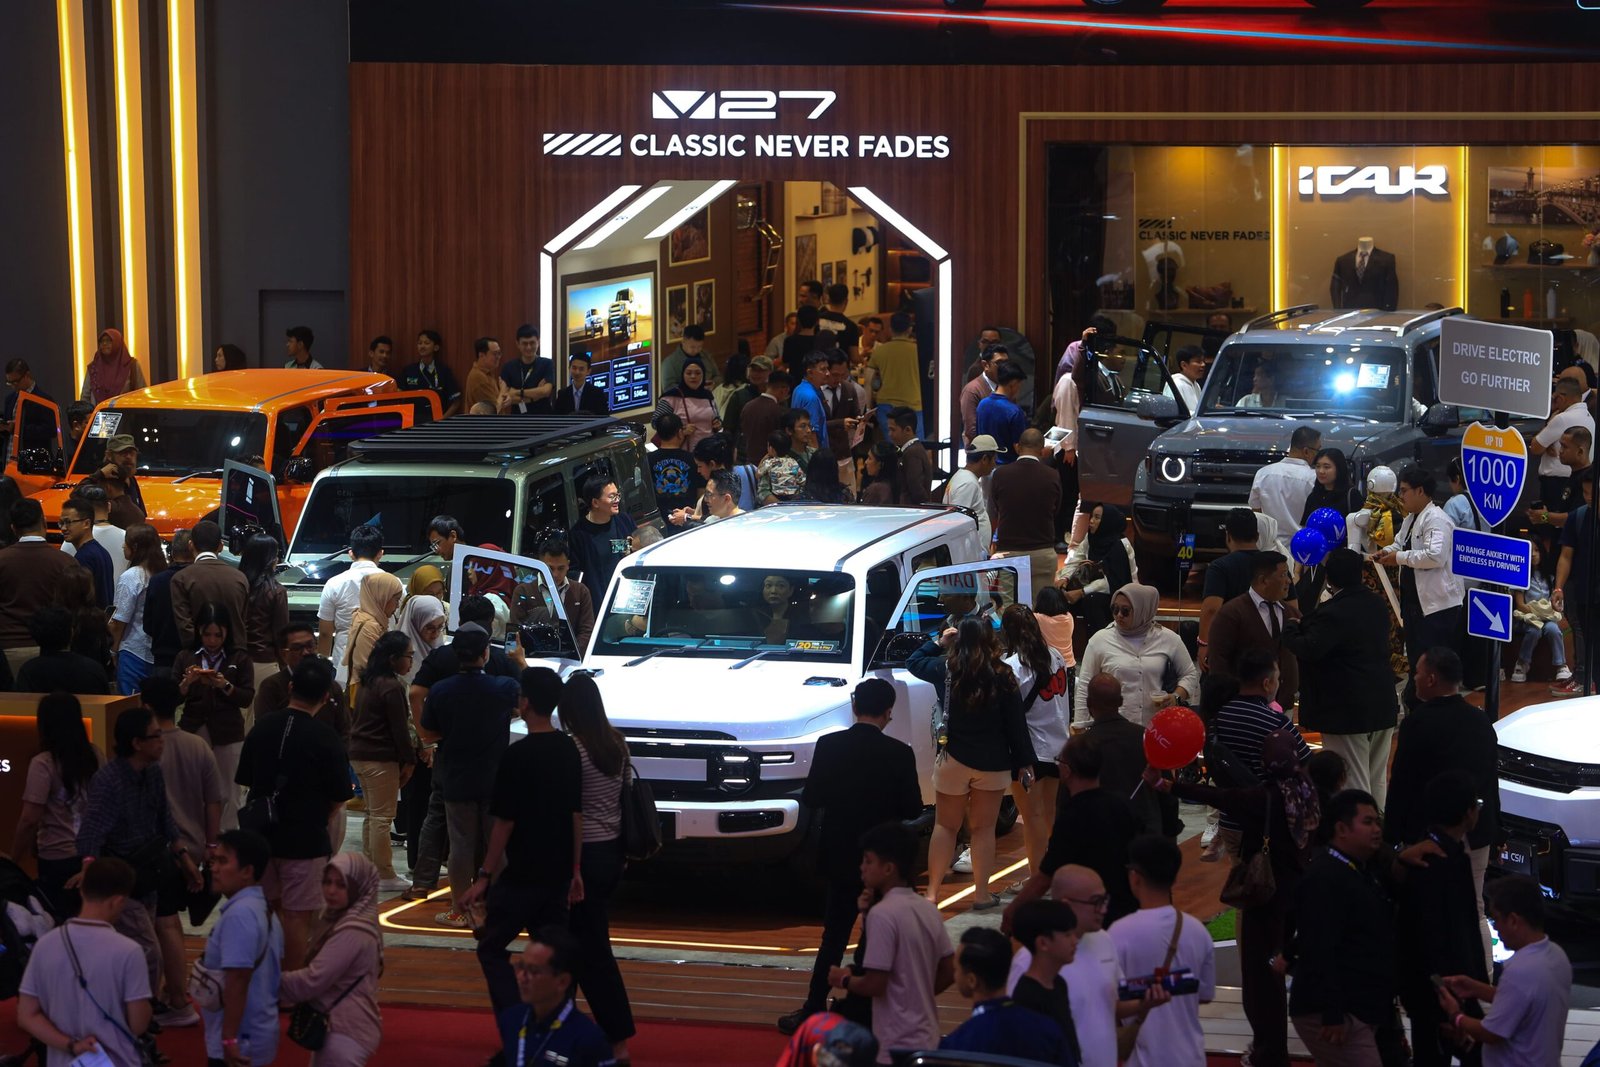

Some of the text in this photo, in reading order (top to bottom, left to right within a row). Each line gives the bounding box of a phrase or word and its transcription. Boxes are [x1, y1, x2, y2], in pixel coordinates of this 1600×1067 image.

[629, 133, 950, 158] CLASSIC NEVER FADES
[1139, 230, 1271, 241] CLASSIC NEVER FADES
[1452, 342, 1541, 366] DRIVE ELECTRIC
[1461, 371, 1530, 393] GO FURTHER
[1484, 435, 1503, 447] UP TO
[1468, 454, 1517, 488] 1000
[1484, 492, 1502, 510] KM
[1177, 545, 1193, 559] 40
[1455, 543, 1525, 563] NO RANGE ANXIETY WITH
[1459, 554, 1520, 572] ENDELESS EV DRIVING
